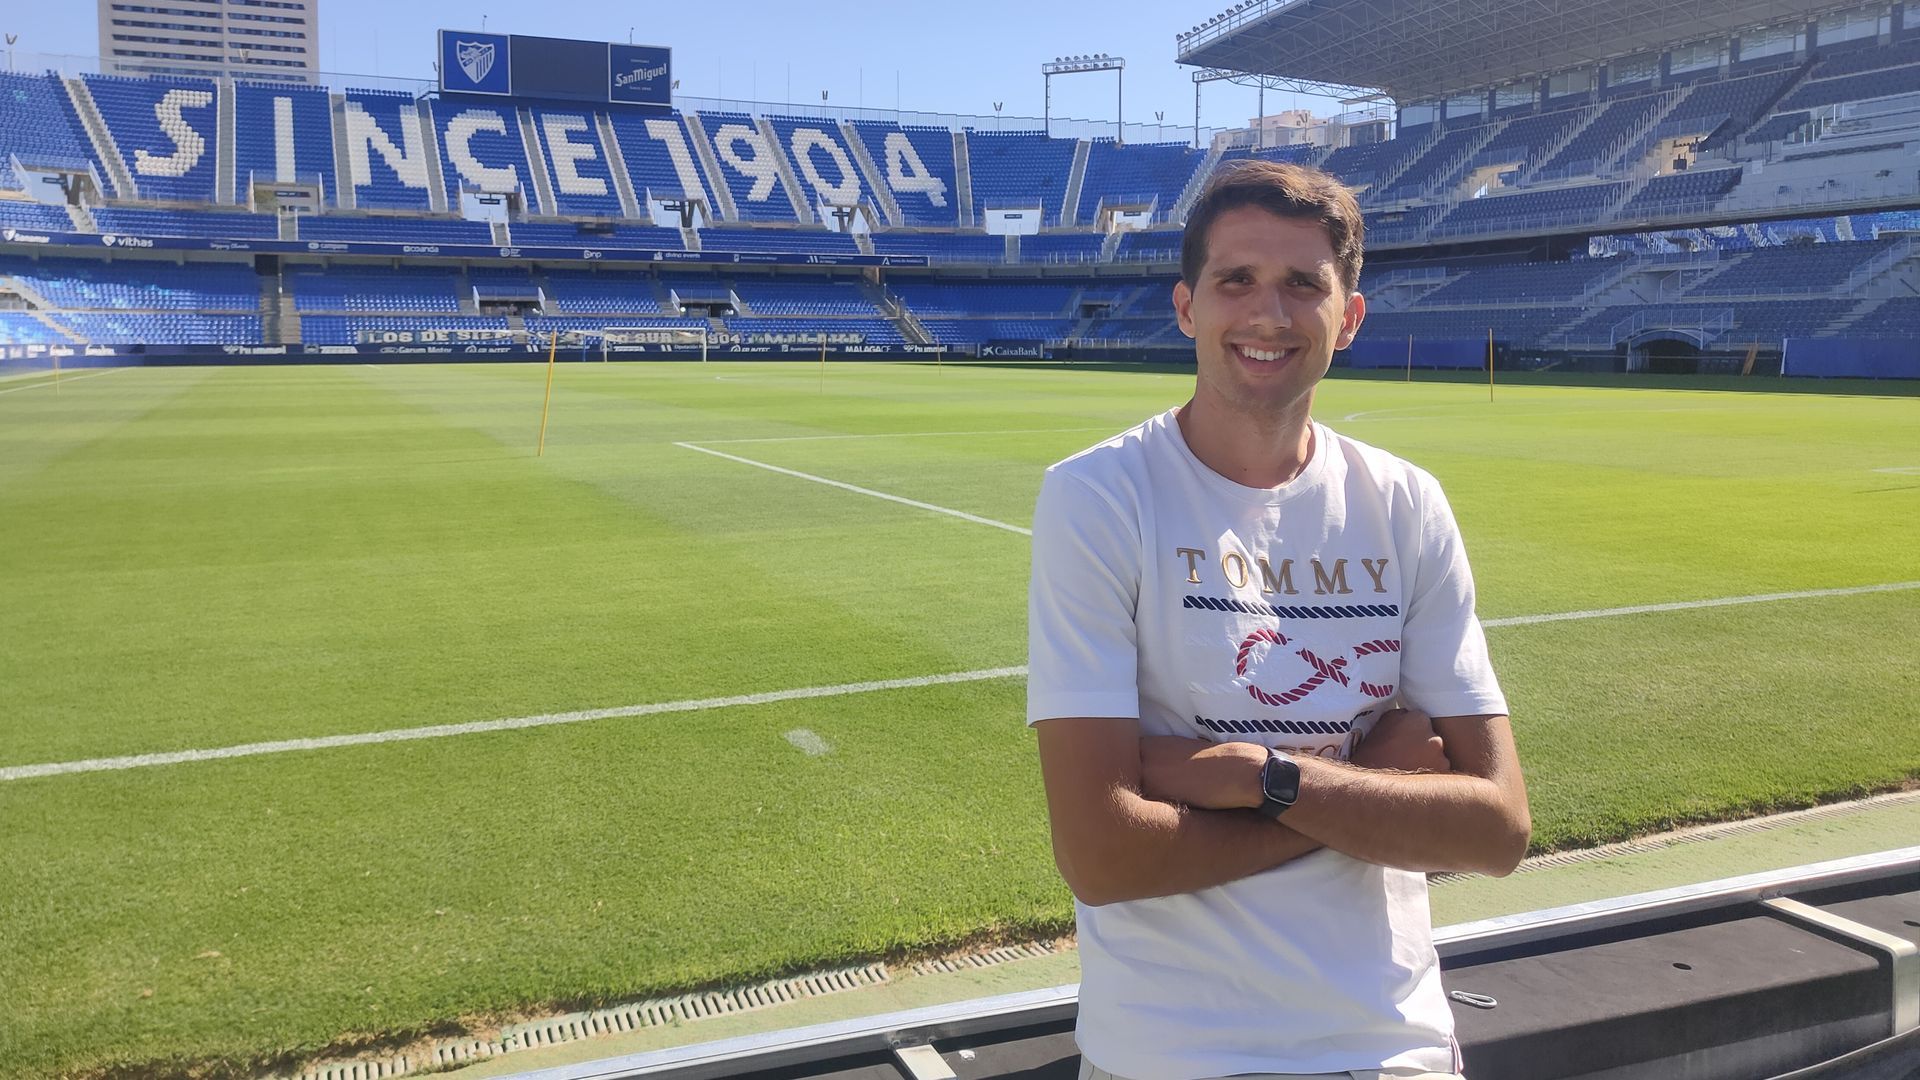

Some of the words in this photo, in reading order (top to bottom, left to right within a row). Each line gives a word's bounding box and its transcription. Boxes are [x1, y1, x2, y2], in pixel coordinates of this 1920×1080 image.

[134, 89, 608, 196] SINCE
[644, 119, 948, 207] 1904
[117, 237, 154, 248] vithas
[368, 331, 413, 343] LOS
[421, 331, 449, 342] DE
[707, 334, 741, 344] 904
[914, 344, 948, 353] hummel
[995, 346, 1038, 356] CaixaBank
[1176, 547, 1389, 595] TOMMY
